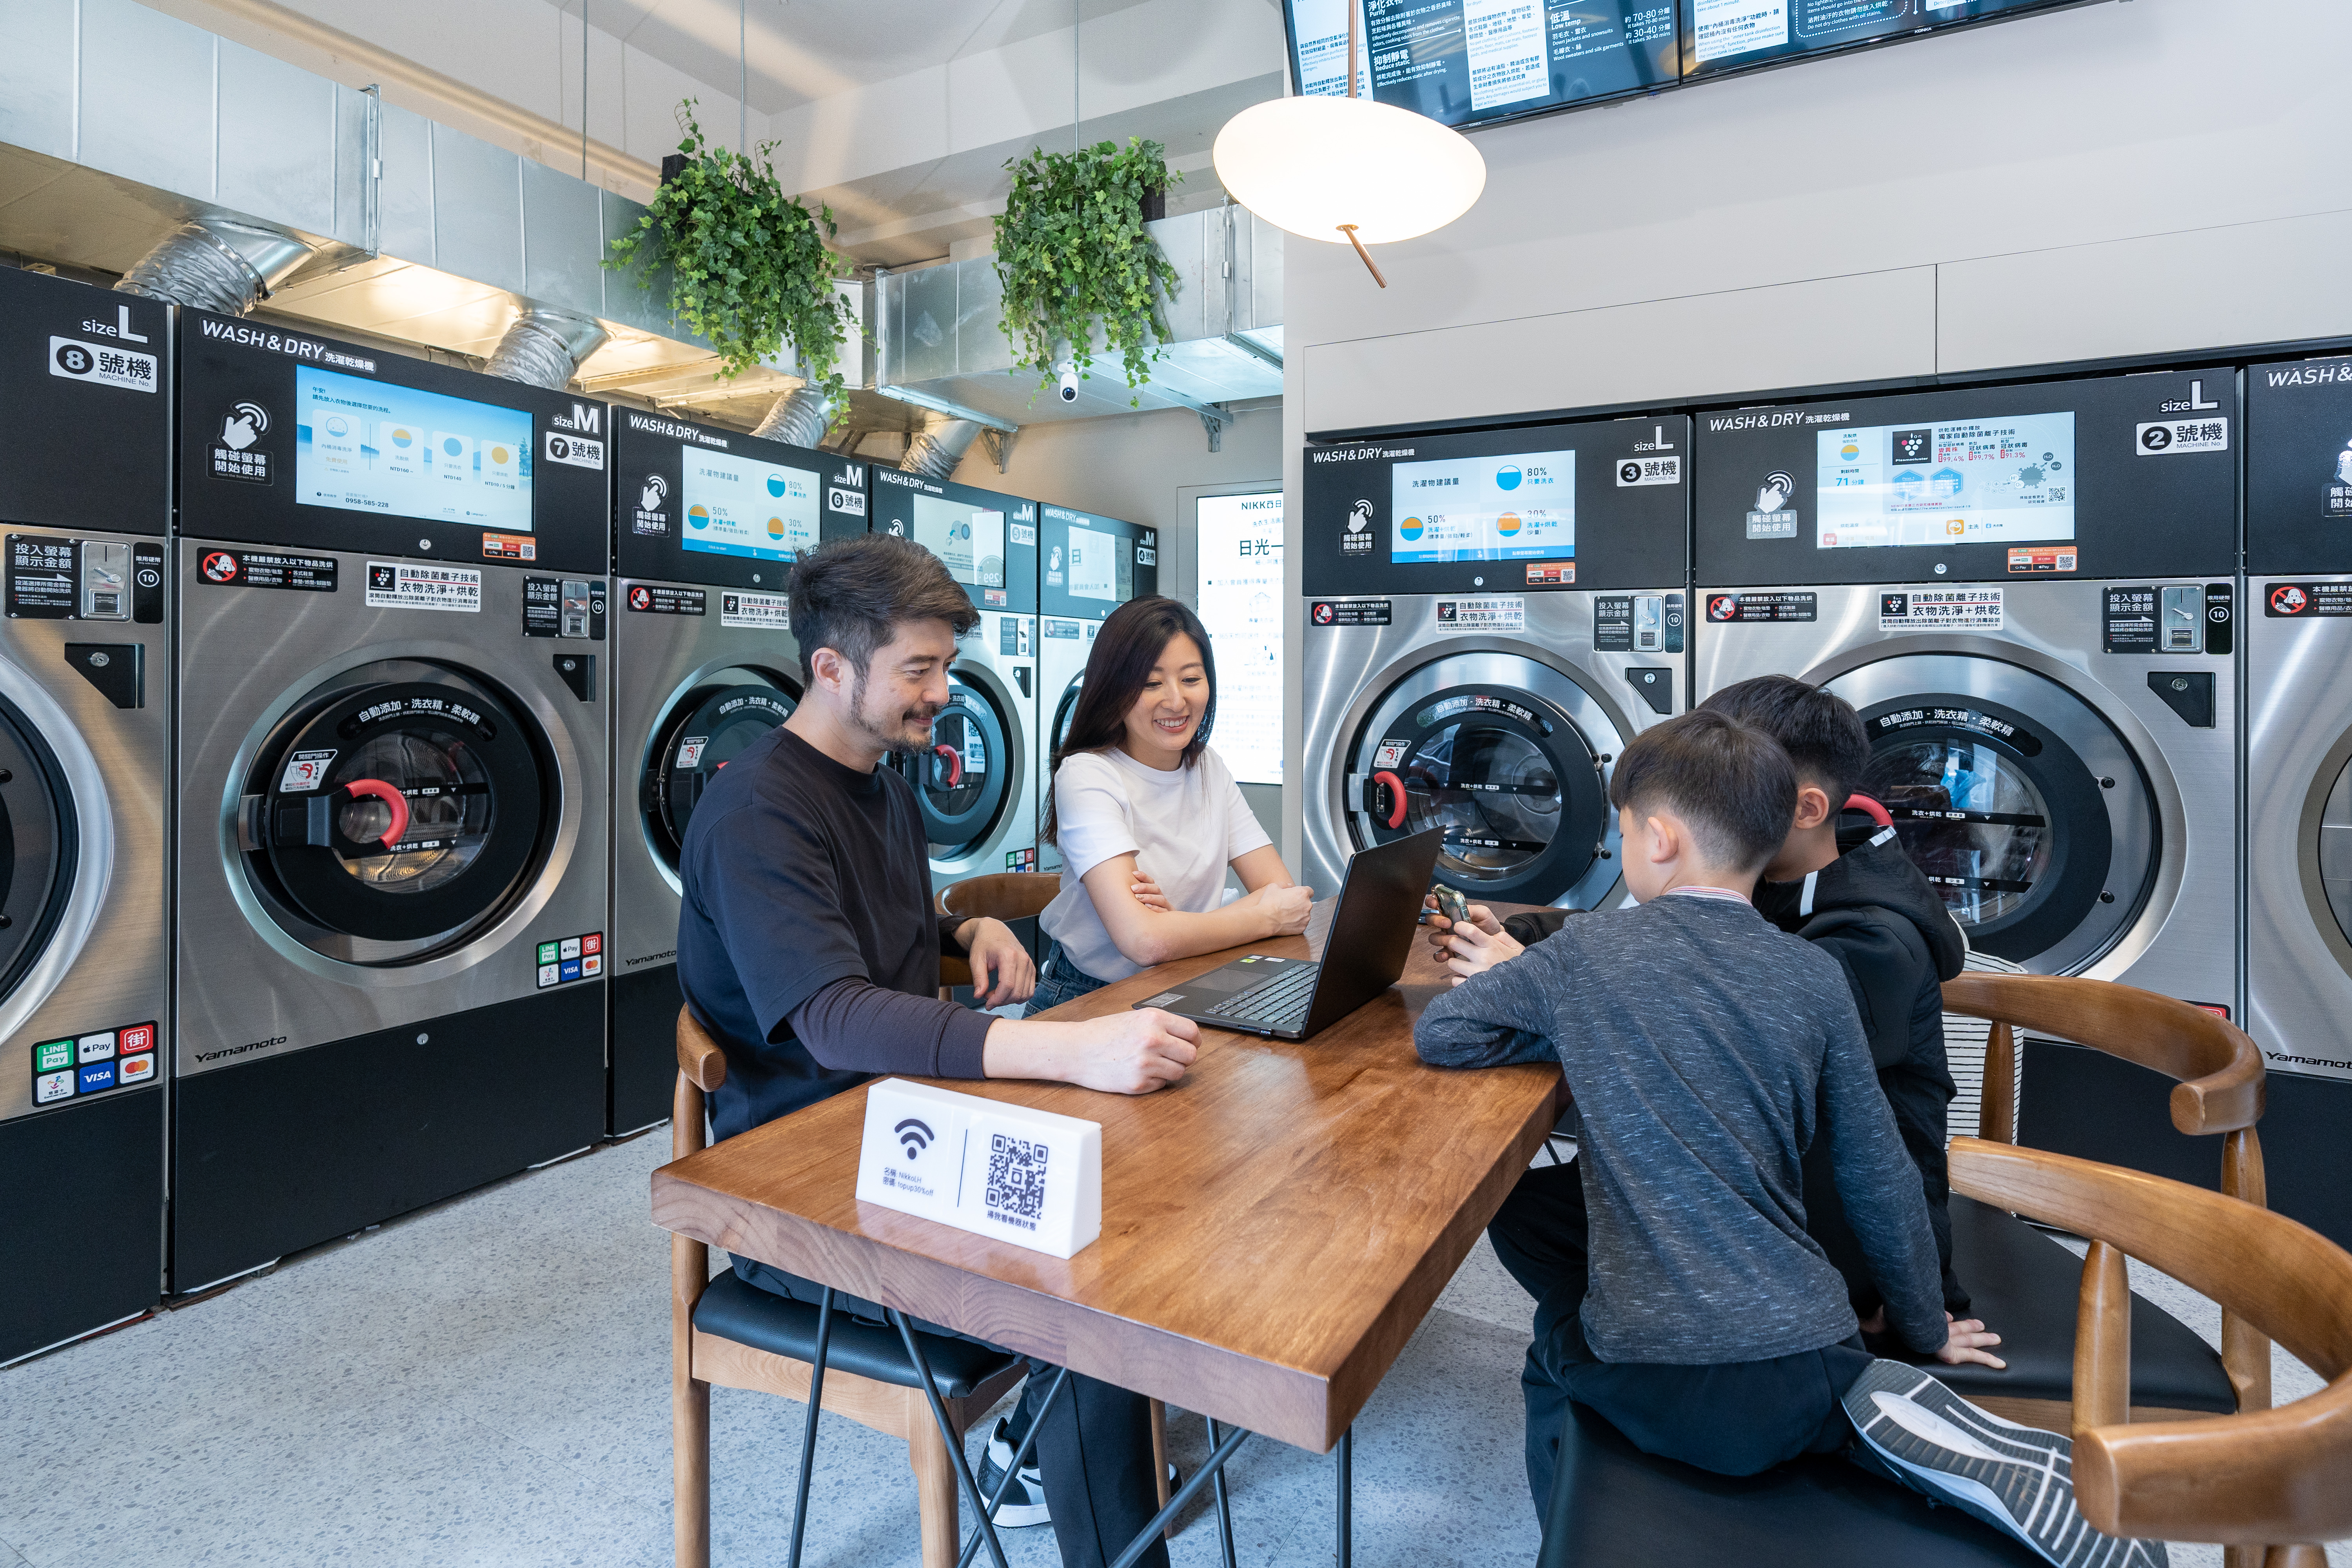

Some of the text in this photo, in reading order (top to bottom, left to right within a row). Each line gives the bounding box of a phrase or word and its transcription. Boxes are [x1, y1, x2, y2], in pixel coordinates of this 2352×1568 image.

[1370, 9, 1385, 17] Purify
[1550, 10, 1570, 24] 低溫
[1633, 9, 1656, 22] 70-80
[1658, 7, 1670, 16] 分鐘
[1552, 22, 1564, 30] Low
[1634, 25, 1657, 38] 30-40
[1658, 23, 1670, 32] 分鐘
[1565, 35, 1581, 44] jackets
[1591, 28, 1613, 37] snowsuits
[1565, 51, 1584, 59] sweaters
[1602, 42, 1624, 51] garments
[1374, 49, 1408, 66] 抑制靜電
[1376, 63, 1394, 71] Reduce
[82, 305, 147, 343] size L
[66, 350, 151, 380] 8 號機
[99, 372, 136, 384] MACHINE
[2161, 381, 2218, 412] size L
[554, 404, 598, 434] size M
[1805, 412, 1850, 424] 洗濯乾燥機
[1634, 426, 1673, 451] size L
[1938, 429, 2015, 439] 獨家自動除菌離子技術
[2149, 423, 2222, 446] 2 號機
[215, 448, 266, 465] 觸碰螢幕
[554, 441, 600, 460] 7 號機
[215, 461, 265, 476] 開始使用
[1527, 467, 1547, 476] 80%
[1626, 461, 1676, 479] 3 號機
[834, 465, 862, 487] size M
[1836, 477, 1849, 487] 71
[789, 481, 802, 490] 80%
[1412, 477, 1459, 488] 洗濯物建議量
[346, 497, 388, 508] 0958-585-228
[845, 495, 862, 509] 號機
[713, 507, 728, 516] 50%
[1527, 510, 1546, 518] 30%
[789, 519, 802, 528] 30%
[1428, 515, 1446, 523] 50%
[1752, 514, 1791, 523] 觸碰螢幕
[1752, 523, 1791, 532] 開始使用
[1021, 528, 1034, 540] 號機
[1343, 534, 1372, 542] 觸碰螢幕
[15, 543, 72, 557] 投入螢幕
[15, 555, 72, 569] 顯示金額
[243, 555, 333, 568] 本機嚴禁放入以下物品洗烘
[400, 568, 478, 583] 自動除菌離子技術
[401, 582, 478, 596] 衣物洗淨+烘乾
[528, 583, 557, 592] 投入螢幕
[528, 592, 557, 601] 顯示金額
[1913, 592, 2000, 602] 自動除菌離子技術
[2110, 593, 2153, 603] 投入螢幕
[1913, 605, 2000, 616] 衣物洗淨+烘乾
[2110, 603, 2153, 612] 顯示金額
[1461, 612, 1522, 621] 衣物洗淨+烘乾
[626, 950, 677, 966] Yamamoto
[564, 966, 578, 974] VISA
[43, 1044, 67, 1054] LINE
[93, 1043, 111, 1052] Pay
[194, 1036, 287, 1063] Yamamoto
[46, 1056, 65, 1064] Pay
[84, 1071, 111, 1083] VISA
[898, 1182, 934, 1196] topup30%off
